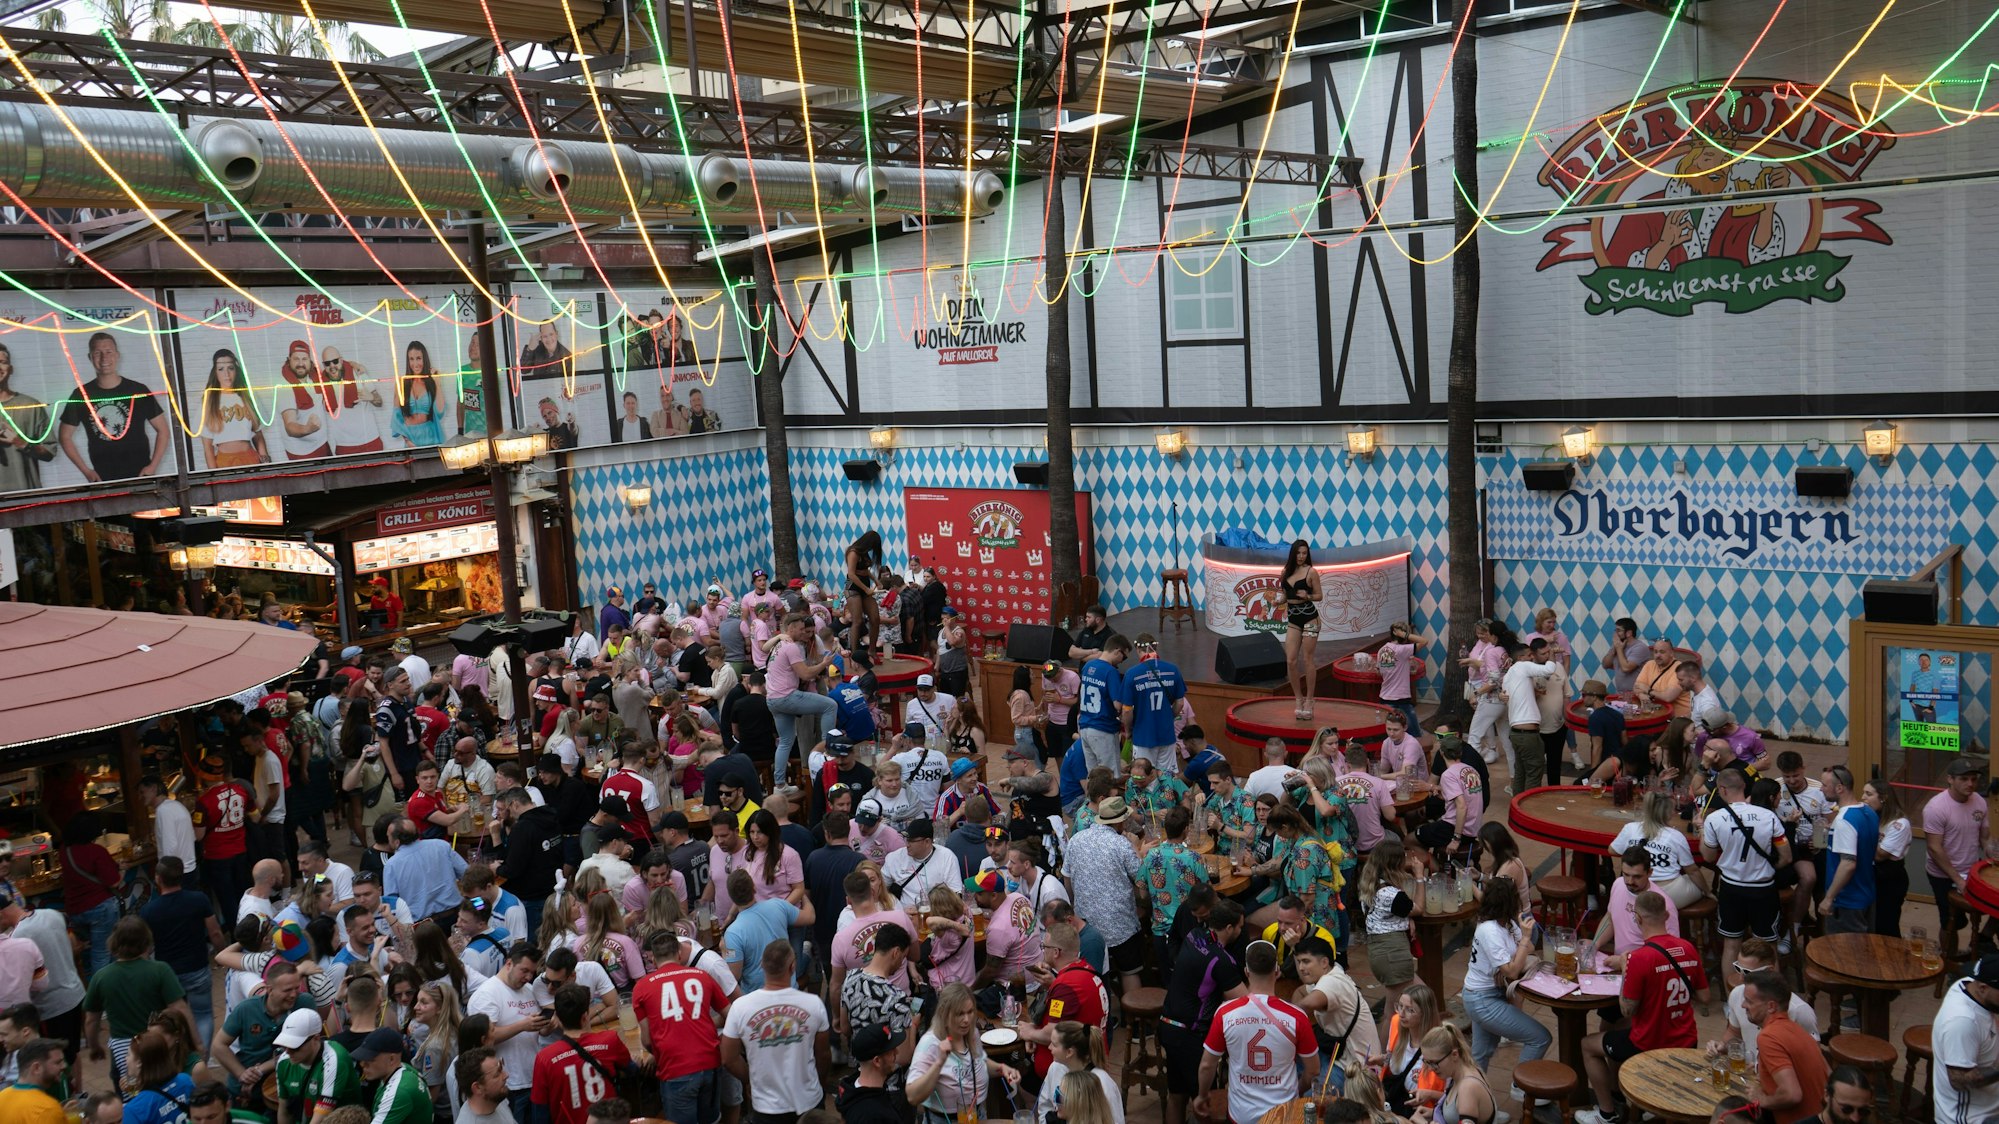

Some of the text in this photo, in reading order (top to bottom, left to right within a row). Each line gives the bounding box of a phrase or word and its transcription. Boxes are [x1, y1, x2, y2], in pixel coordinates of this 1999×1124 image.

[1552, 87, 1867, 195] BIERKÖNIG
[1607, 264, 1820, 304] Schinkenstrasse
[947, 298, 985, 320] DEIN
[914, 321, 1027, 351] WOHNZIMMER
[943, 348, 994, 362] AUF MALLORCA!
[407, 498, 426, 506] einen
[426, 494, 454, 504] leckeren
[454, 491, 474, 500] Snack
[474, 488, 491, 497] beim
[384, 504, 478, 527] GRILL KÖNIG
[970, 503, 1021, 521] BIERKÖNIG
[1553, 488, 1861, 560] Oberbayern
[1237, 578, 1282, 597] BIERKÖ
[1080, 683, 1102, 714] 13
[1149, 691, 1164, 712] 17
[1902, 722, 1929, 732] HEUTE
[1930, 735, 1958, 748] LIVE!
[907, 761, 943, 769] BIEKÖNIG
[914, 768, 942, 782] 988
[1731, 826, 1755, 863] 7
[660, 978, 705, 1022] 49
[1227, 1018, 1235, 1027] FC
[1235, 1017, 1260, 1026] BAYERN
[1247, 1029, 1273, 1072] 6
[564, 1060, 606, 1110] 18
[1239, 1074, 1282, 1085] KIMMICH
